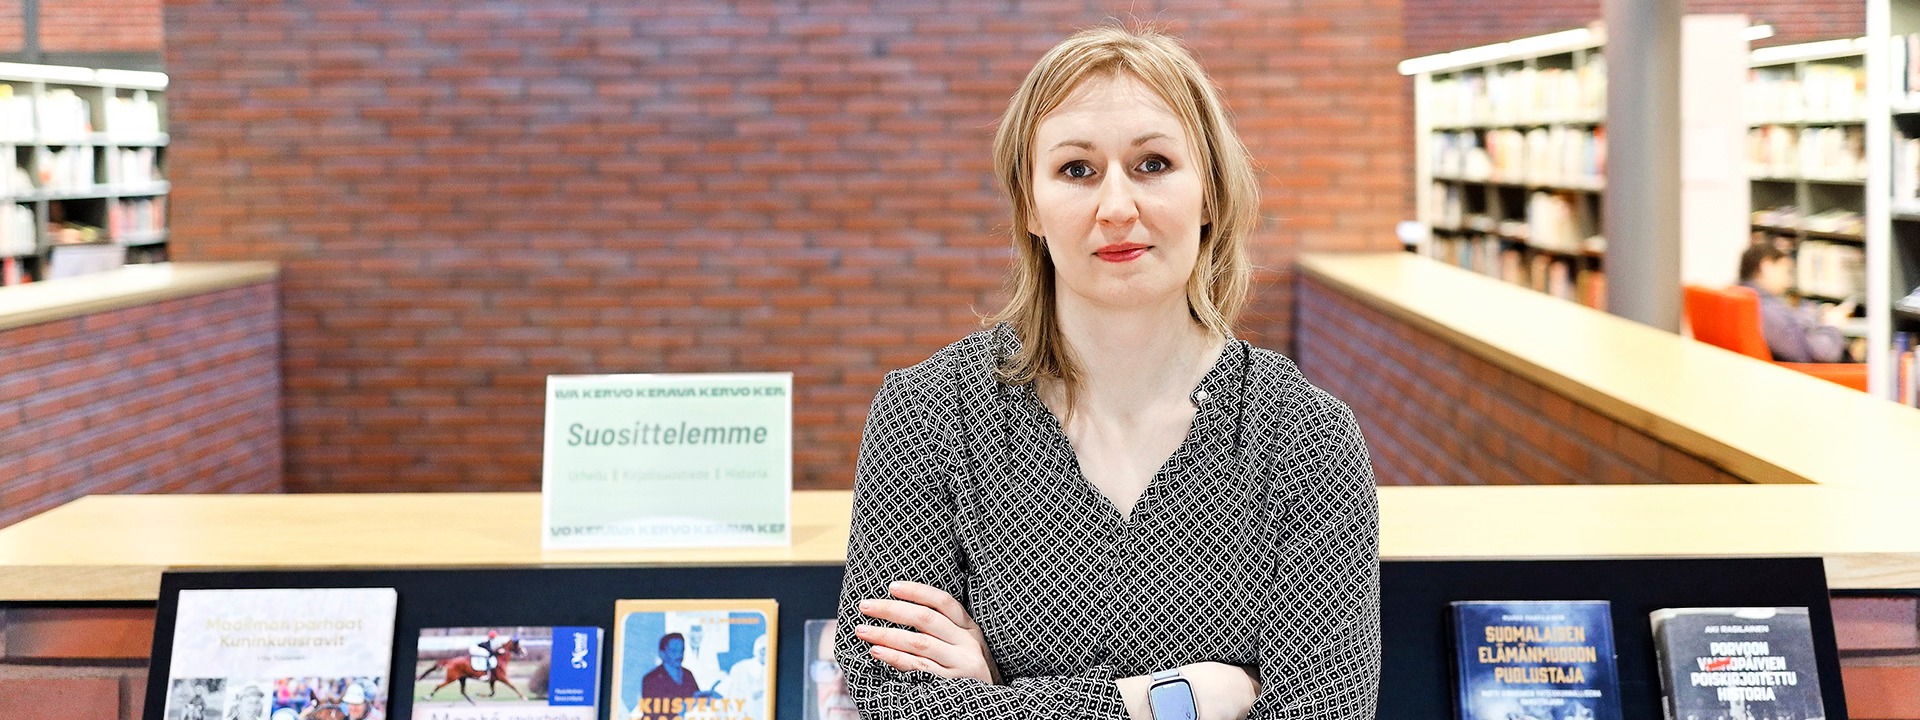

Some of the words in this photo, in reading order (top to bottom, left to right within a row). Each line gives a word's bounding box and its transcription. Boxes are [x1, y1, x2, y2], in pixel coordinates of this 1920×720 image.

[583, 388, 633, 398] KERVO
[636, 387, 695, 397] KERAVA
[700, 387, 750, 397] KERVO
[567, 421, 768, 446] Suosittelemme
[205, 618, 290, 632] Maailman
[294, 617, 363, 634] parhaat
[219, 635, 346, 649] Kuninkuusravit
[1485, 626, 1586, 643] SUOMALAINEN
[1478, 643, 1597, 663] ELÄMÄNMUODON
[1710, 642, 1769, 656] PORVOON
[1494, 667, 1585, 684] PUOLUSTAJA
[1690, 671, 1797, 687] POISKIRJOITETTU
[1717, 687, 1776, 701] HISTORIA
[638, 697, 745, 714] KIISTELTY
